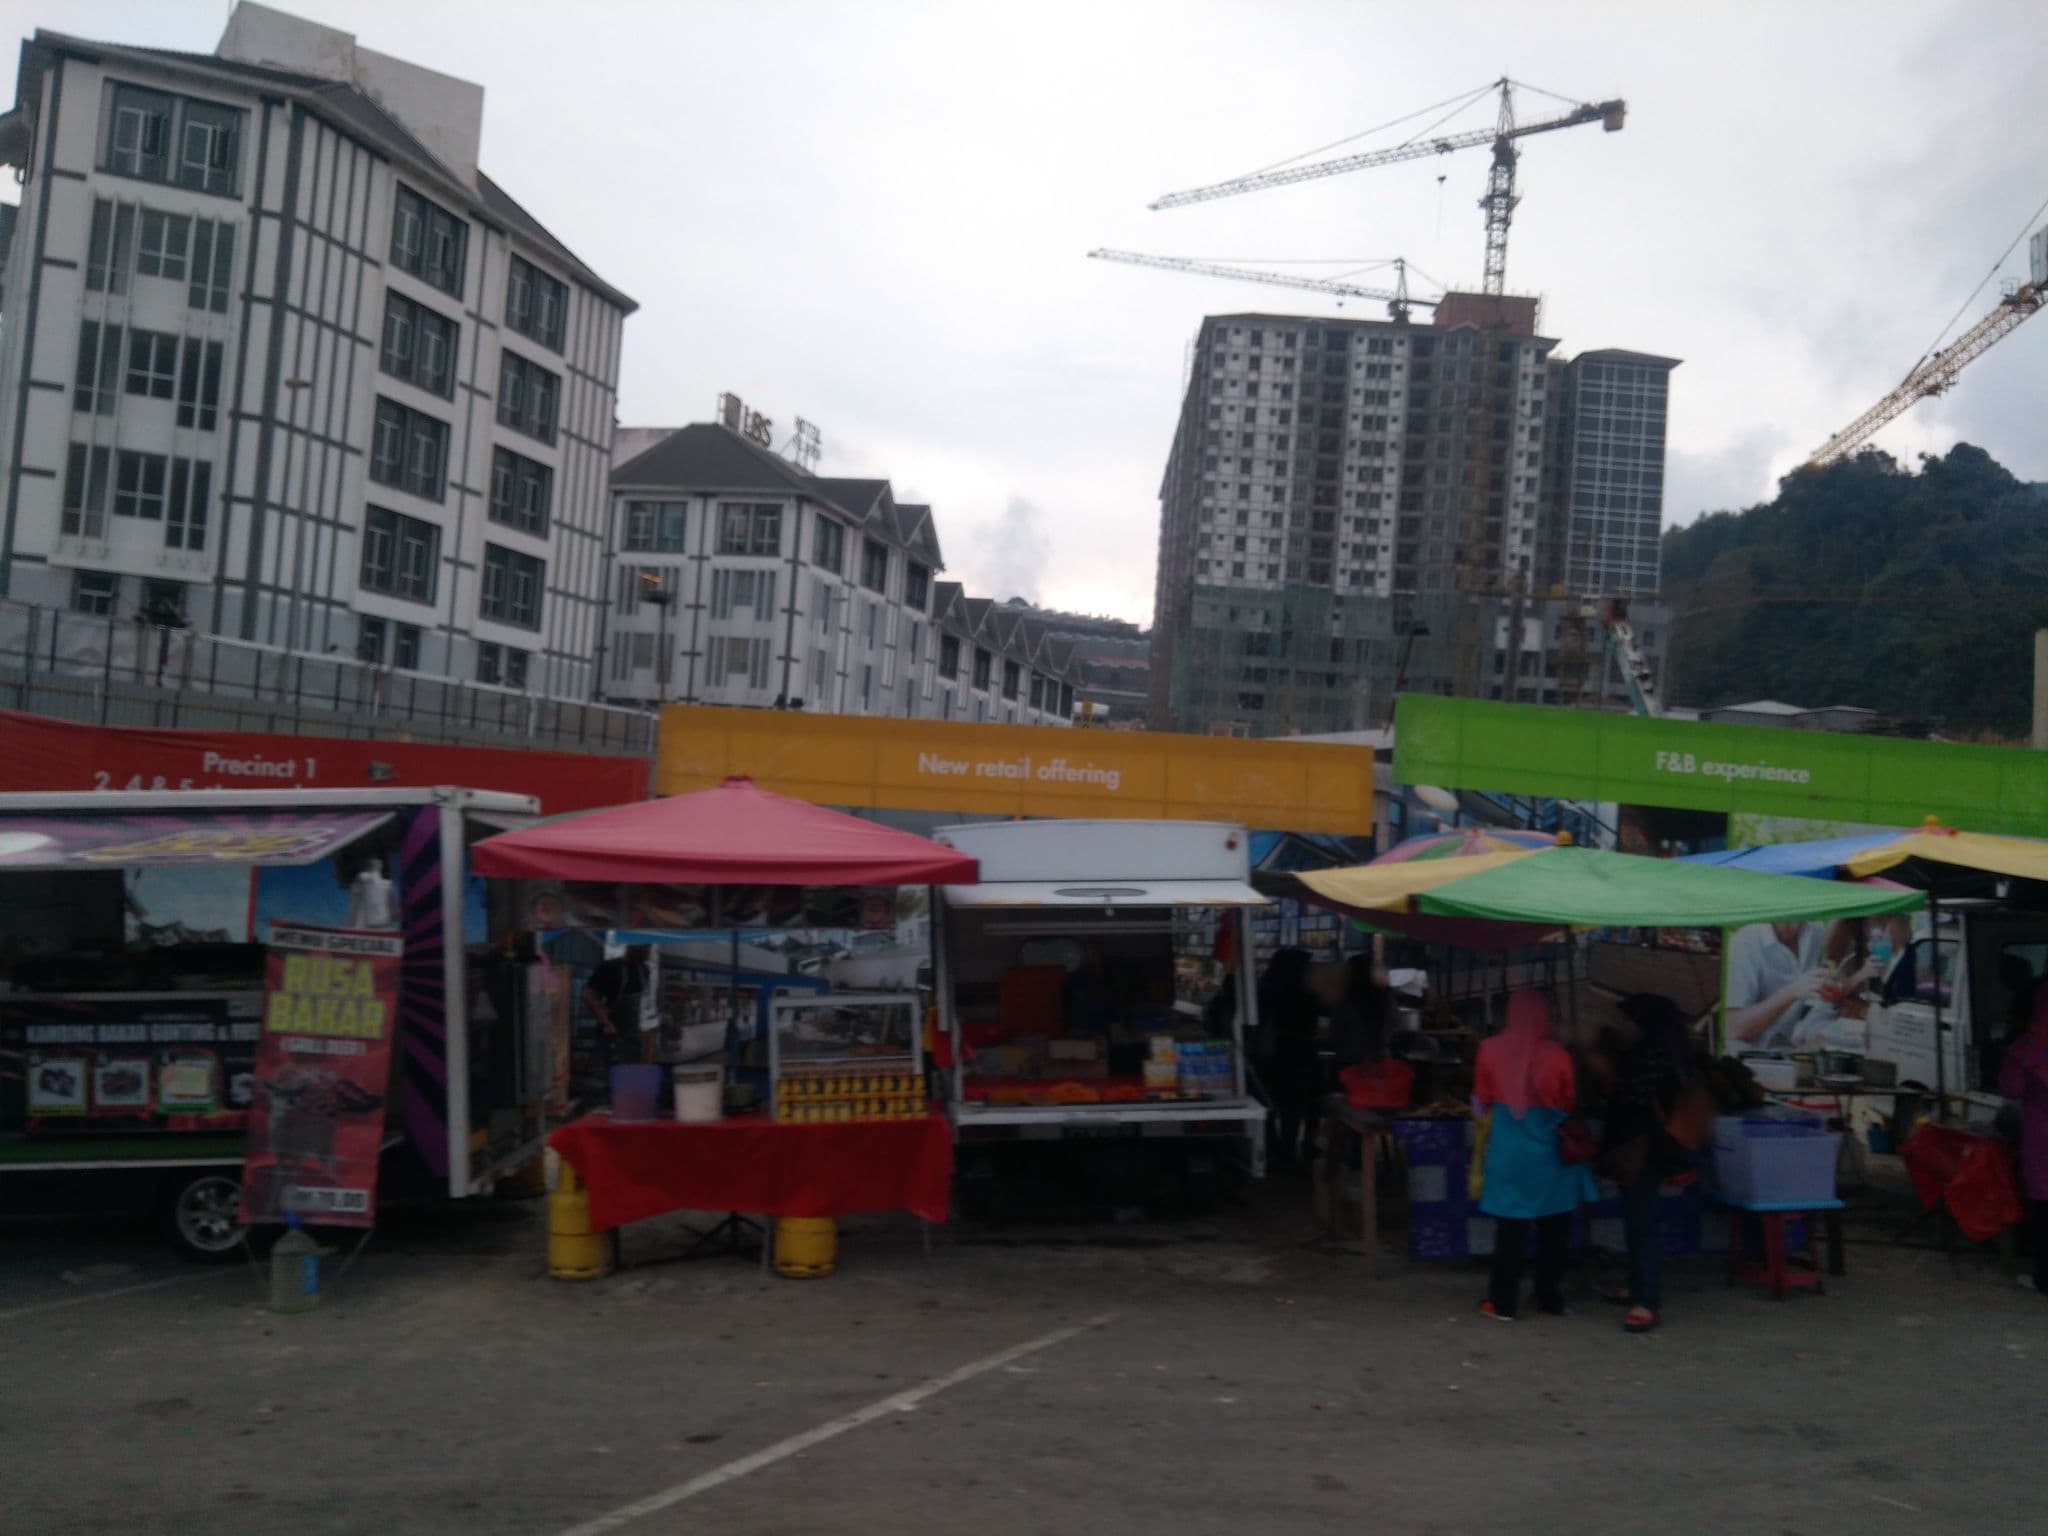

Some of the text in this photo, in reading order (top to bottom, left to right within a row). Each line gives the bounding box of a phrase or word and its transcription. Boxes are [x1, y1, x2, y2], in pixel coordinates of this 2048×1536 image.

[202, 751, 316, 779] Precinct 1
[918, 752, 1121, 790] New retail offering
[1656, 751, 1811, 784] F&B experience
[283, 954, 375, 998] RUSA
[265, 992, 386, 1040] BAKAR
